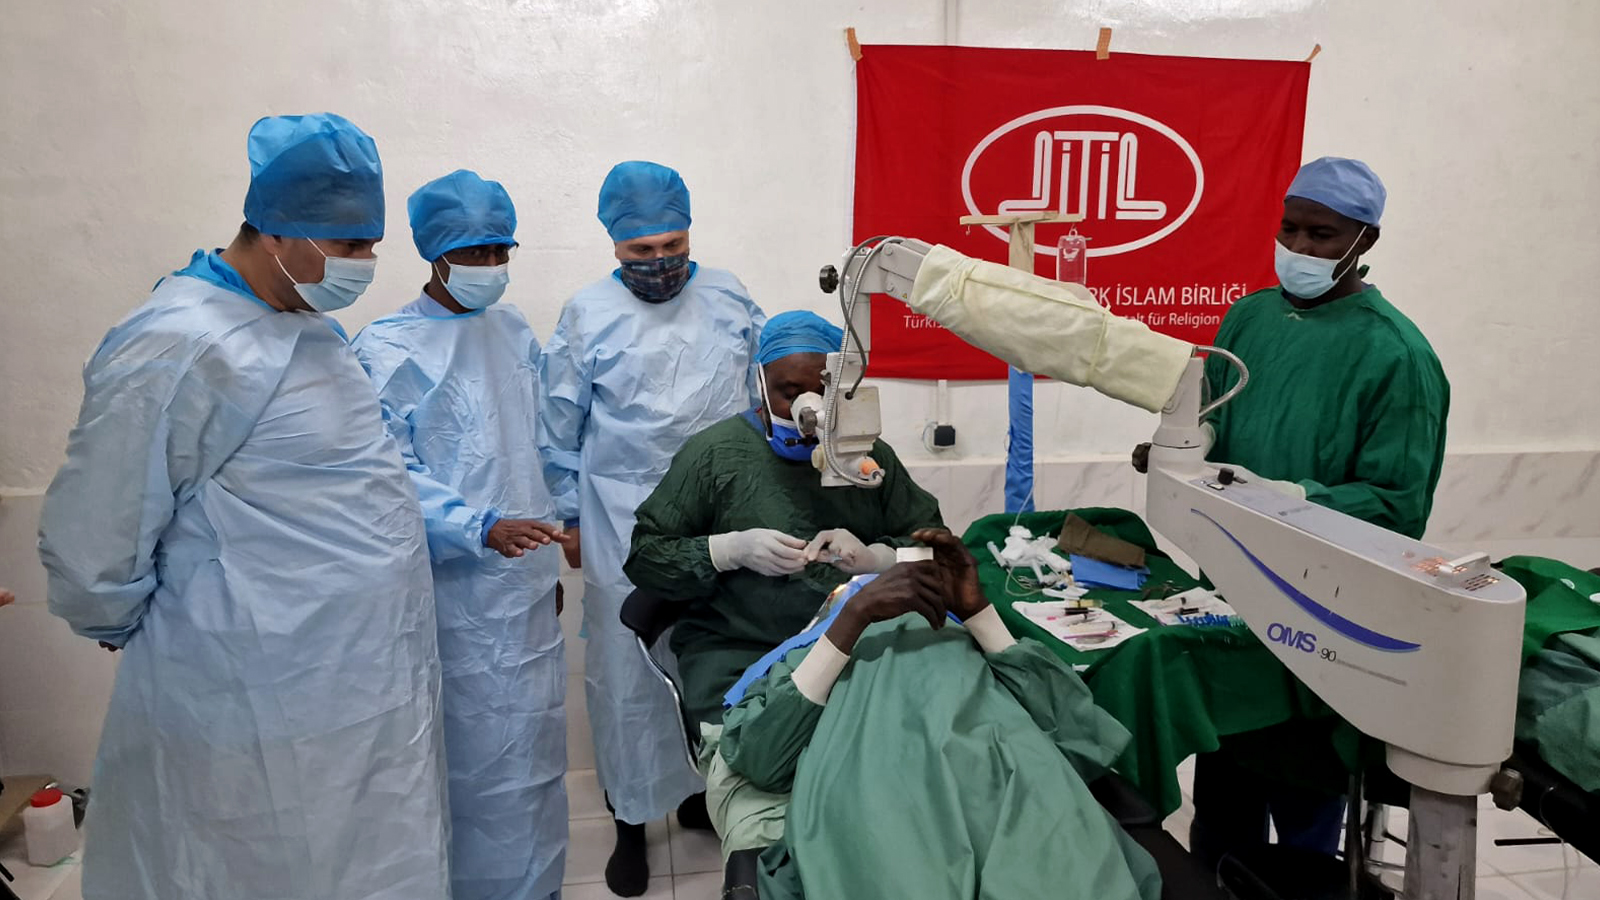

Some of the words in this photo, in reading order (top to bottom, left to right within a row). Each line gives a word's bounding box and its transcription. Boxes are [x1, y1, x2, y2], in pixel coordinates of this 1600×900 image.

[1116, 283, 1176, 306] İSLAM
[1148, 312, 1166, 326] für
[1169, 312, 1220, 329] Religion
